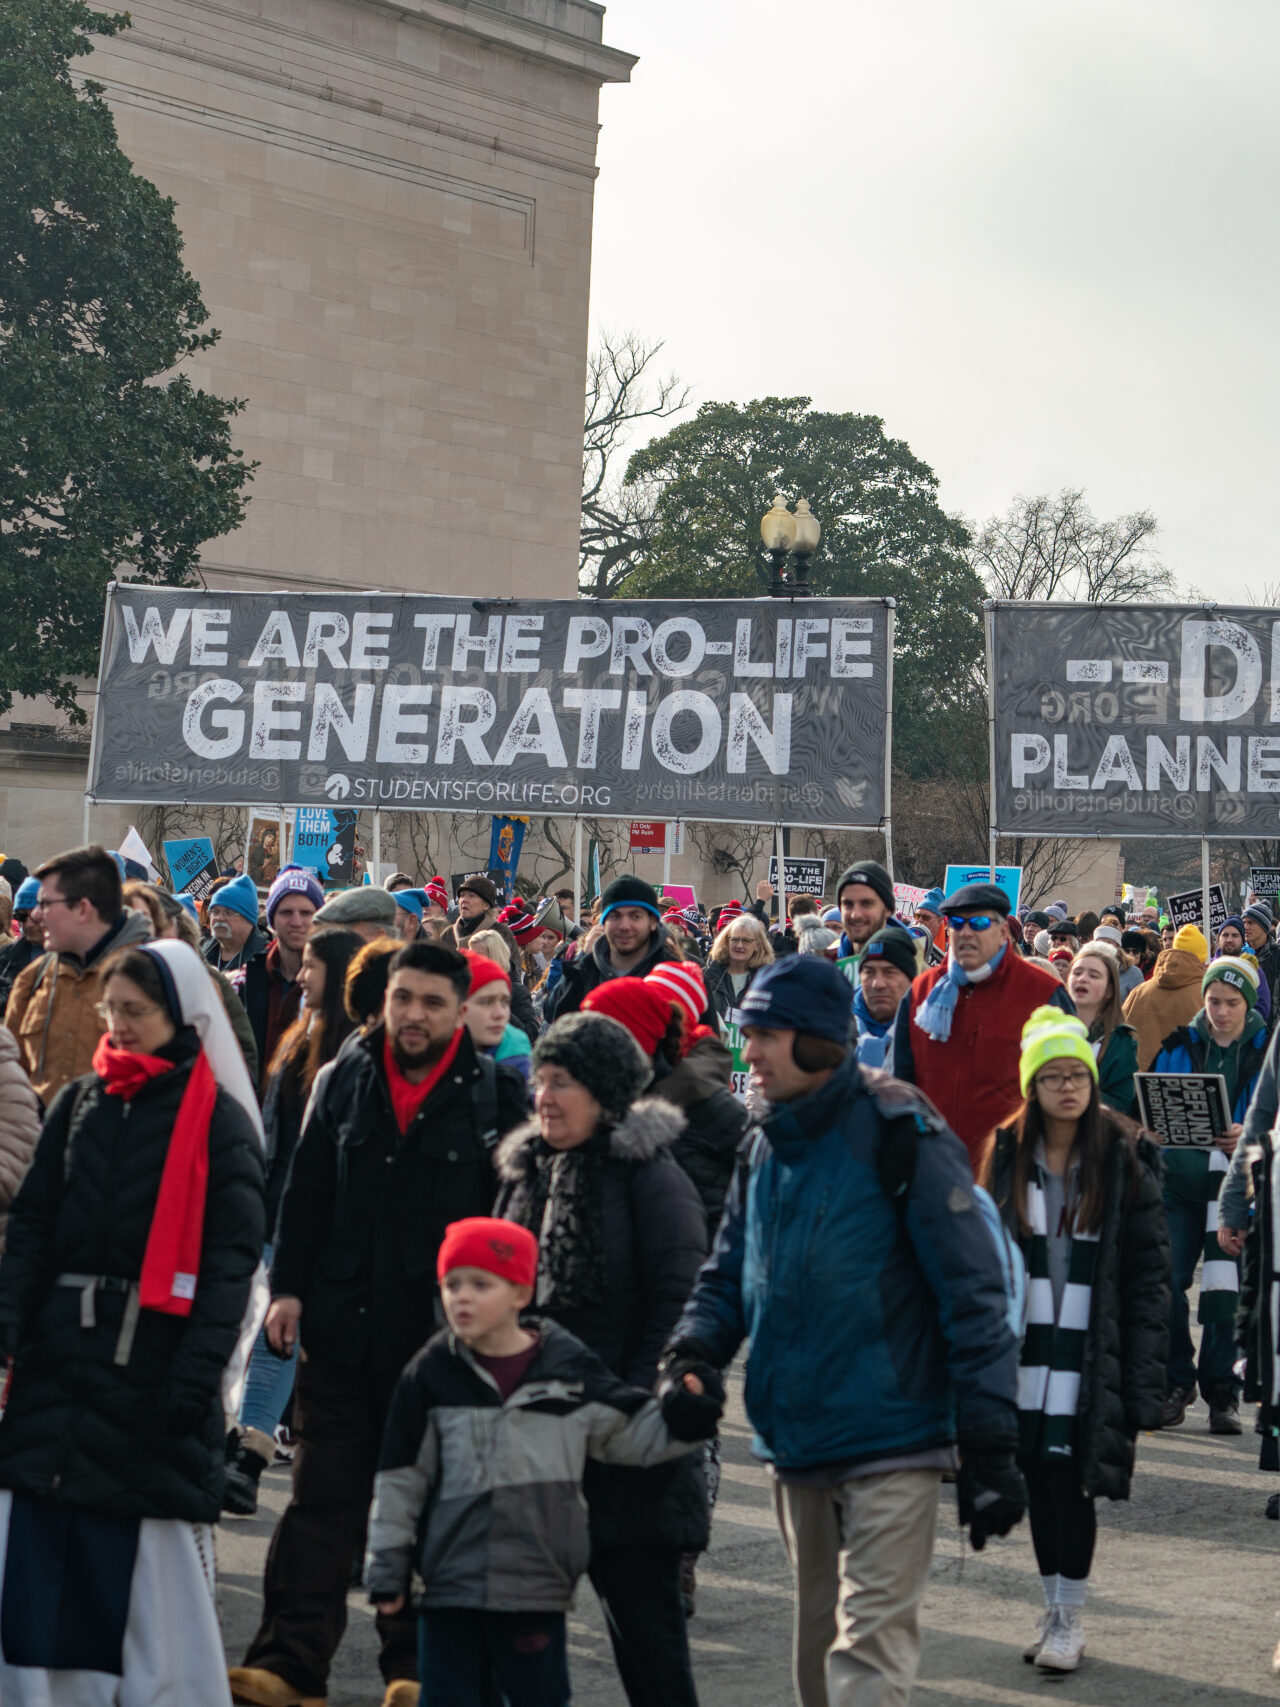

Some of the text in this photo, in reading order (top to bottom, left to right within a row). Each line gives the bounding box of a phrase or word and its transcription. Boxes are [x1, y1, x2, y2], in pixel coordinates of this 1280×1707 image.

[122, 604, 874, 678] WE ARE THE PRO-LIFE
[182, 678, 793, 775] GENERATION
[354, 778, 611, 806] STUDENTSFORLIFE.ORG
[299, 808, 328, 820] LOVE
[298, 819, 331, 834] THEM
[297, 833, 329, 847] BOTH
[172, 841, 202, 873] WOMEN'S
[185, 852, 209, 876] RIGHTS
[771, 873, 823, 885] PO-LIFE
[801, 867, 821, 875] THE
[1182, 900, 1197, 911] AM
[1160, 1077, 1190, 1145] PLANNED
[1181, 1078, 1214, 1146] DEFUND
